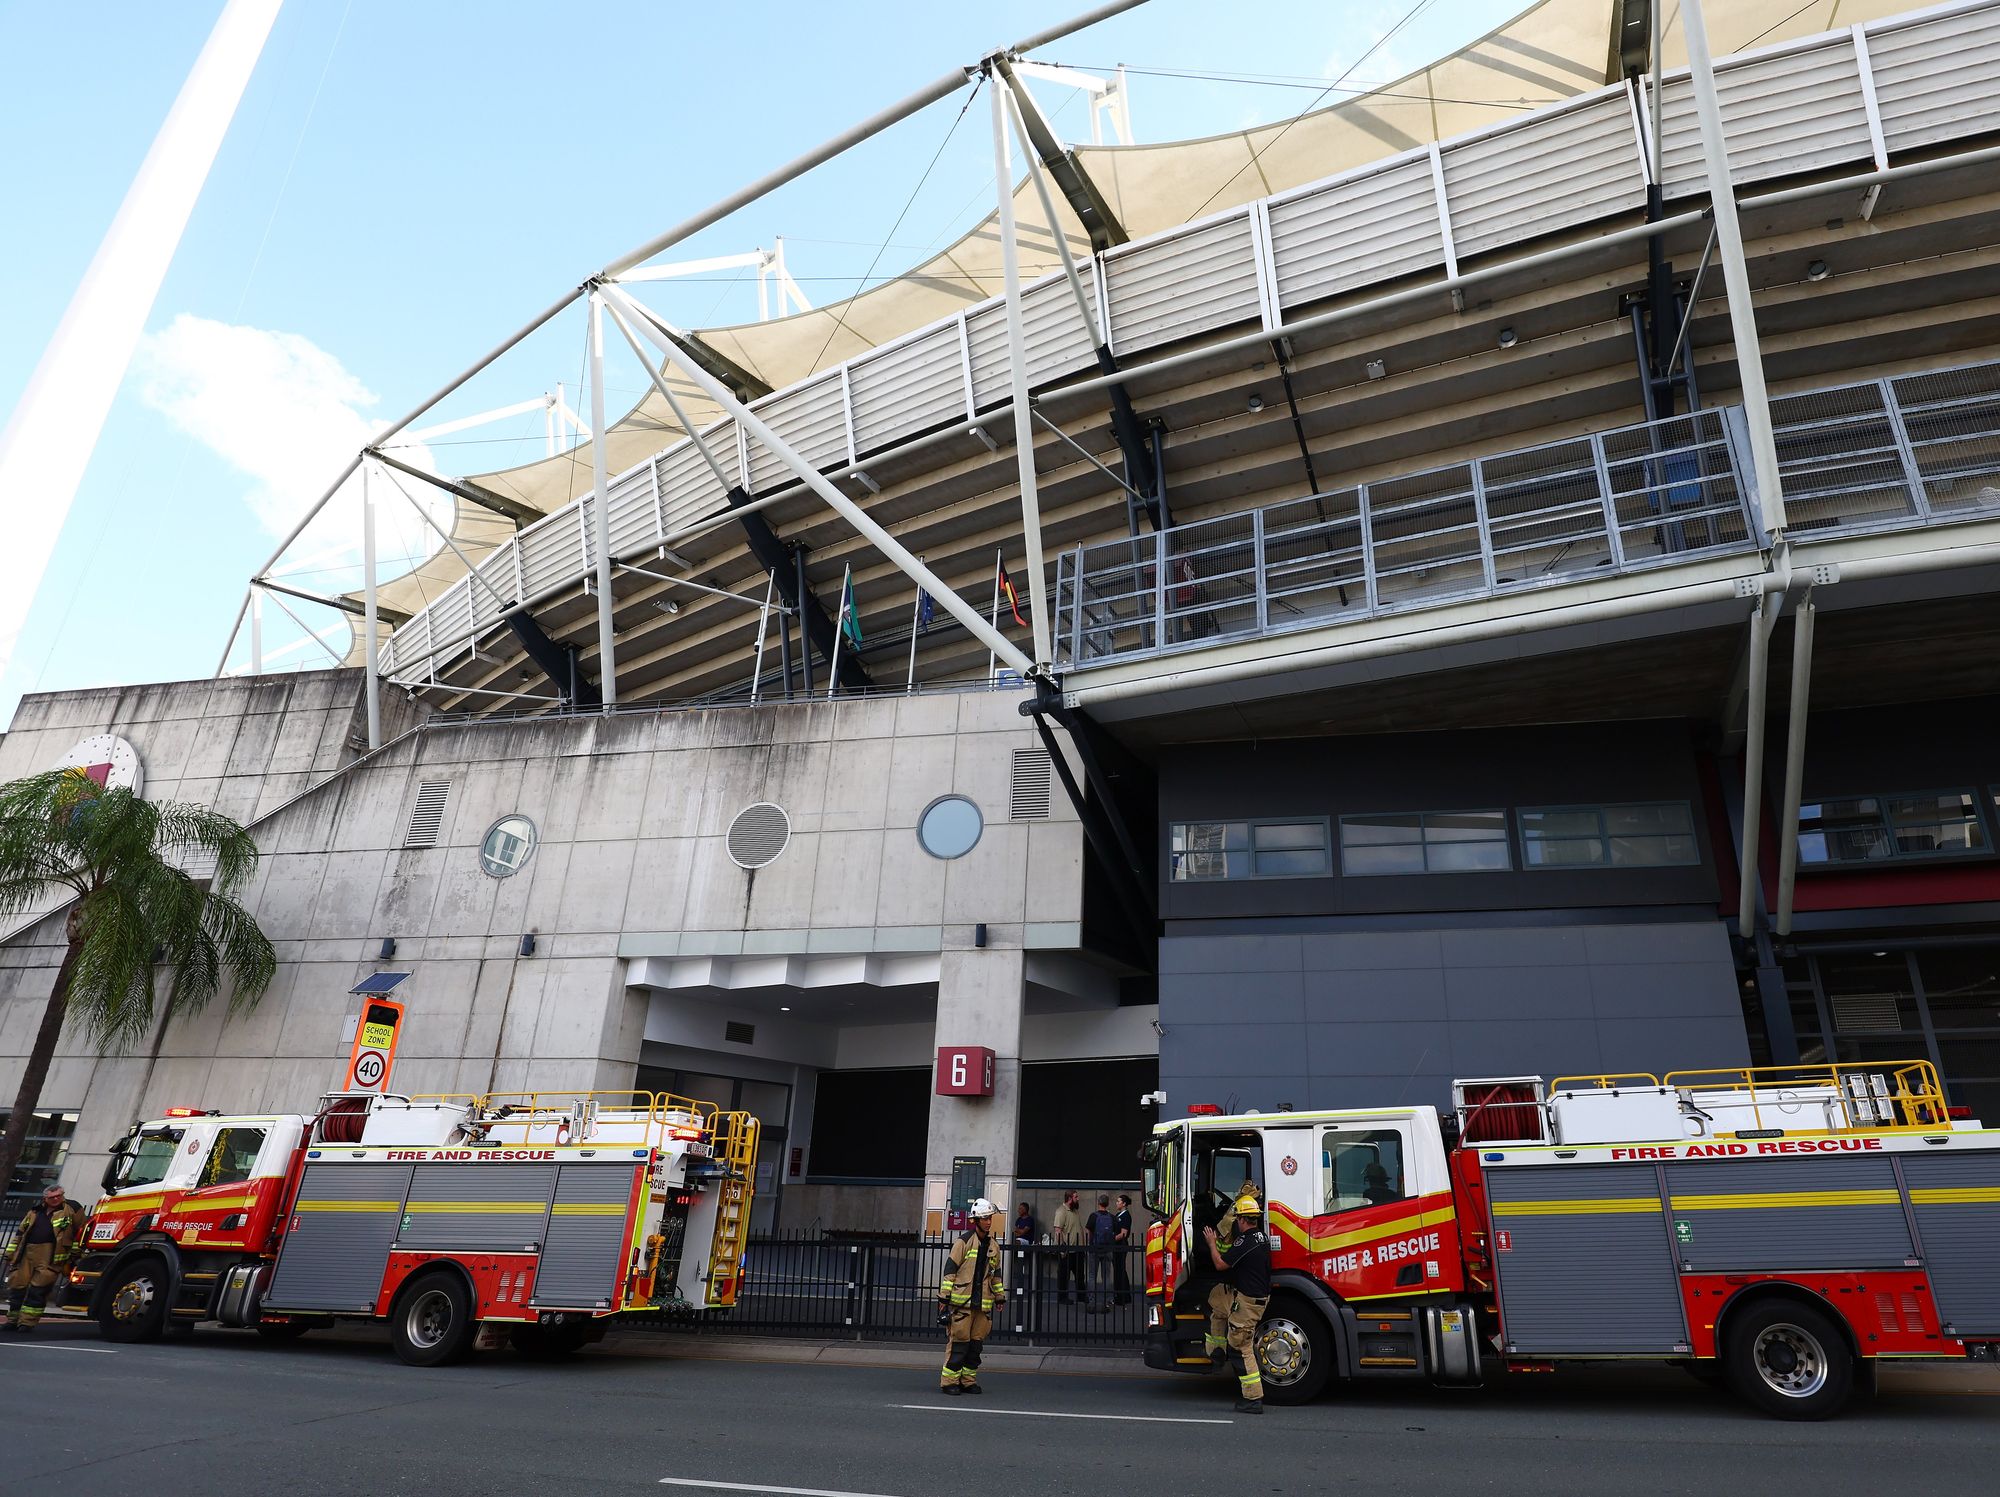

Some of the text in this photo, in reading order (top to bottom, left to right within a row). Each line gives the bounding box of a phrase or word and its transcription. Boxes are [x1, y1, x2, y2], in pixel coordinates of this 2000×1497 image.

[365, 1026, 391, 1037] SCHOOL
[367, 1036, 386, 1045] ZONE
[359, 1060, 380, 1078] 40
[951, 1054, 967, 1087] 6
[985, 1056, 992, 1088] 6
[386, 1150, 556, 1160] FIRE AND RESCUE
[1611, 1138, 1883, 1160] FIRE AND RESCUE
[183, 1222, 214, 1231] RESCUE
[94, 1230, 106, 1239] 503
[1323, 1232, 1440, 1277] FIRE & RESCUE
